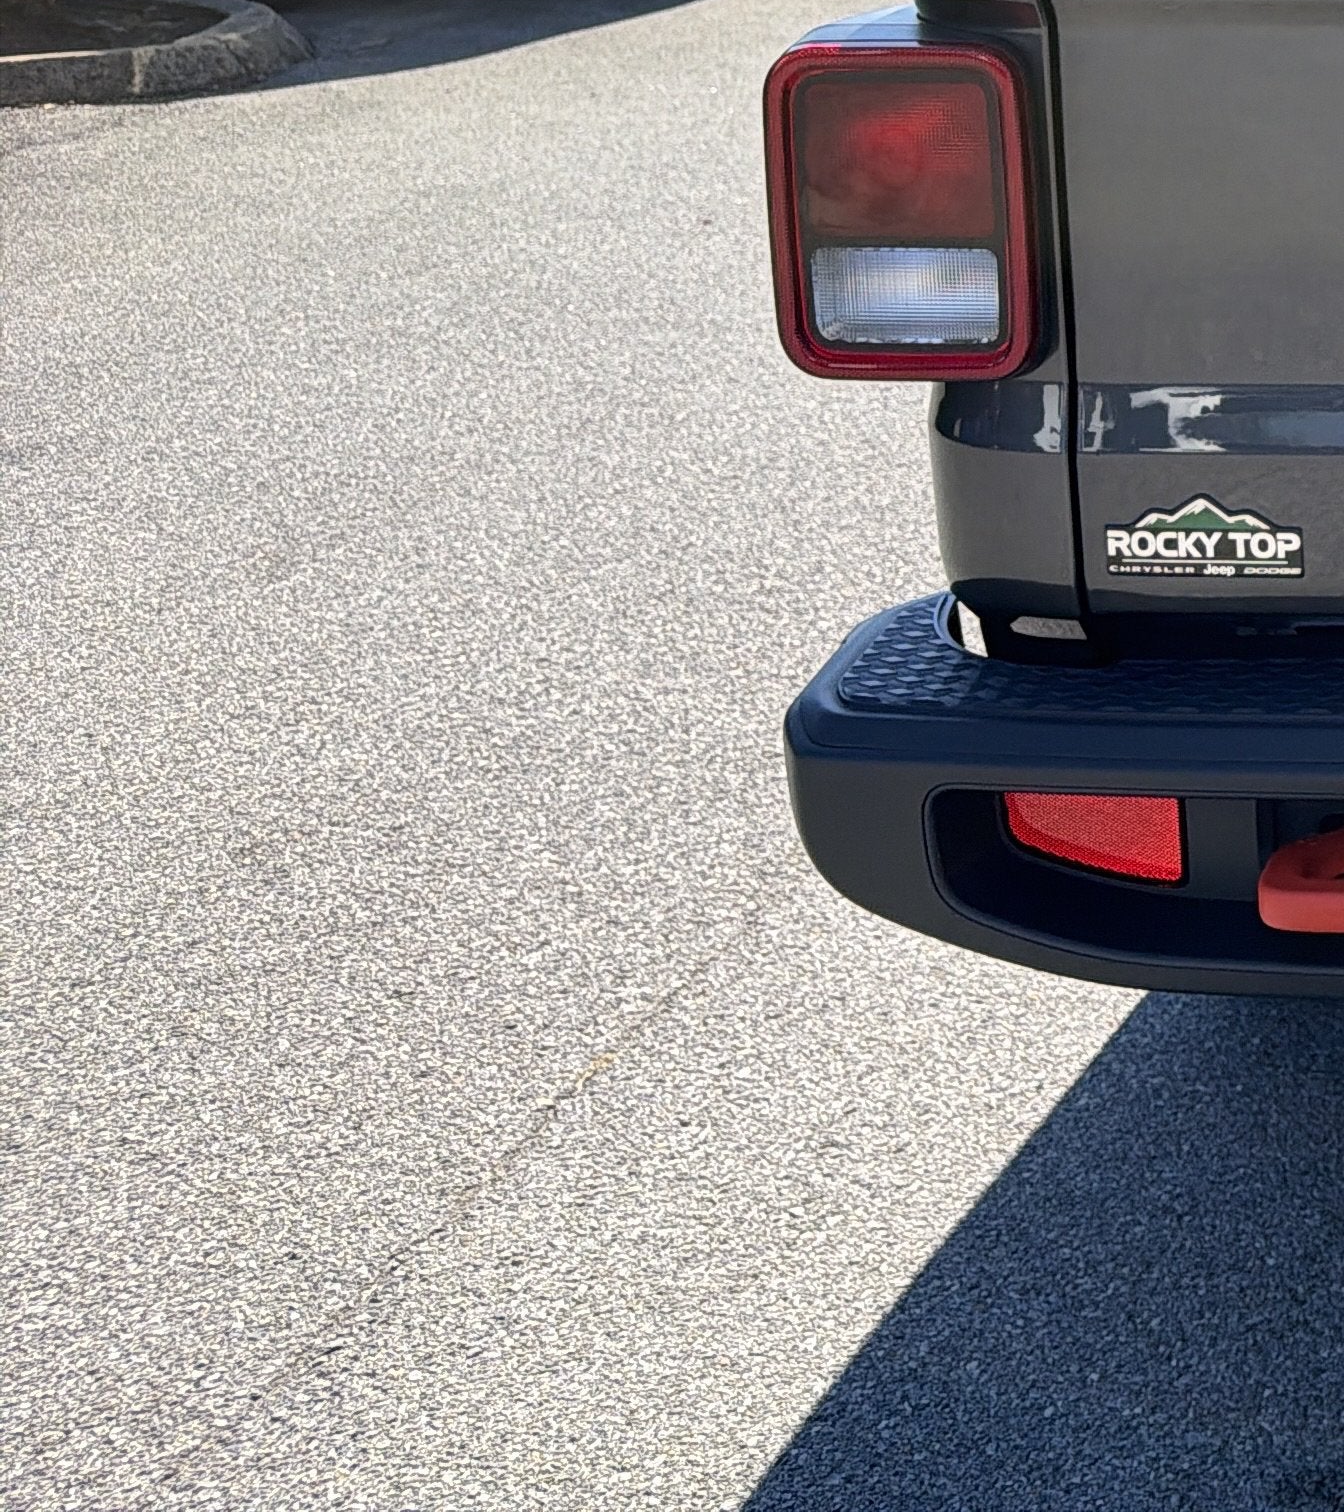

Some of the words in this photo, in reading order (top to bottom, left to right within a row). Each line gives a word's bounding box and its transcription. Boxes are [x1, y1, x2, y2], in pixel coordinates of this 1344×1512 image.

[1106, 530, 1222, 558] ROCKY
[1228, 531, 1301, 559] TOP
[1108, 565, 1195, 574] CHRYSLER
[1203, 564, 1236, 576] Jeep
[1243, 567, 1302, 575] DODGE
